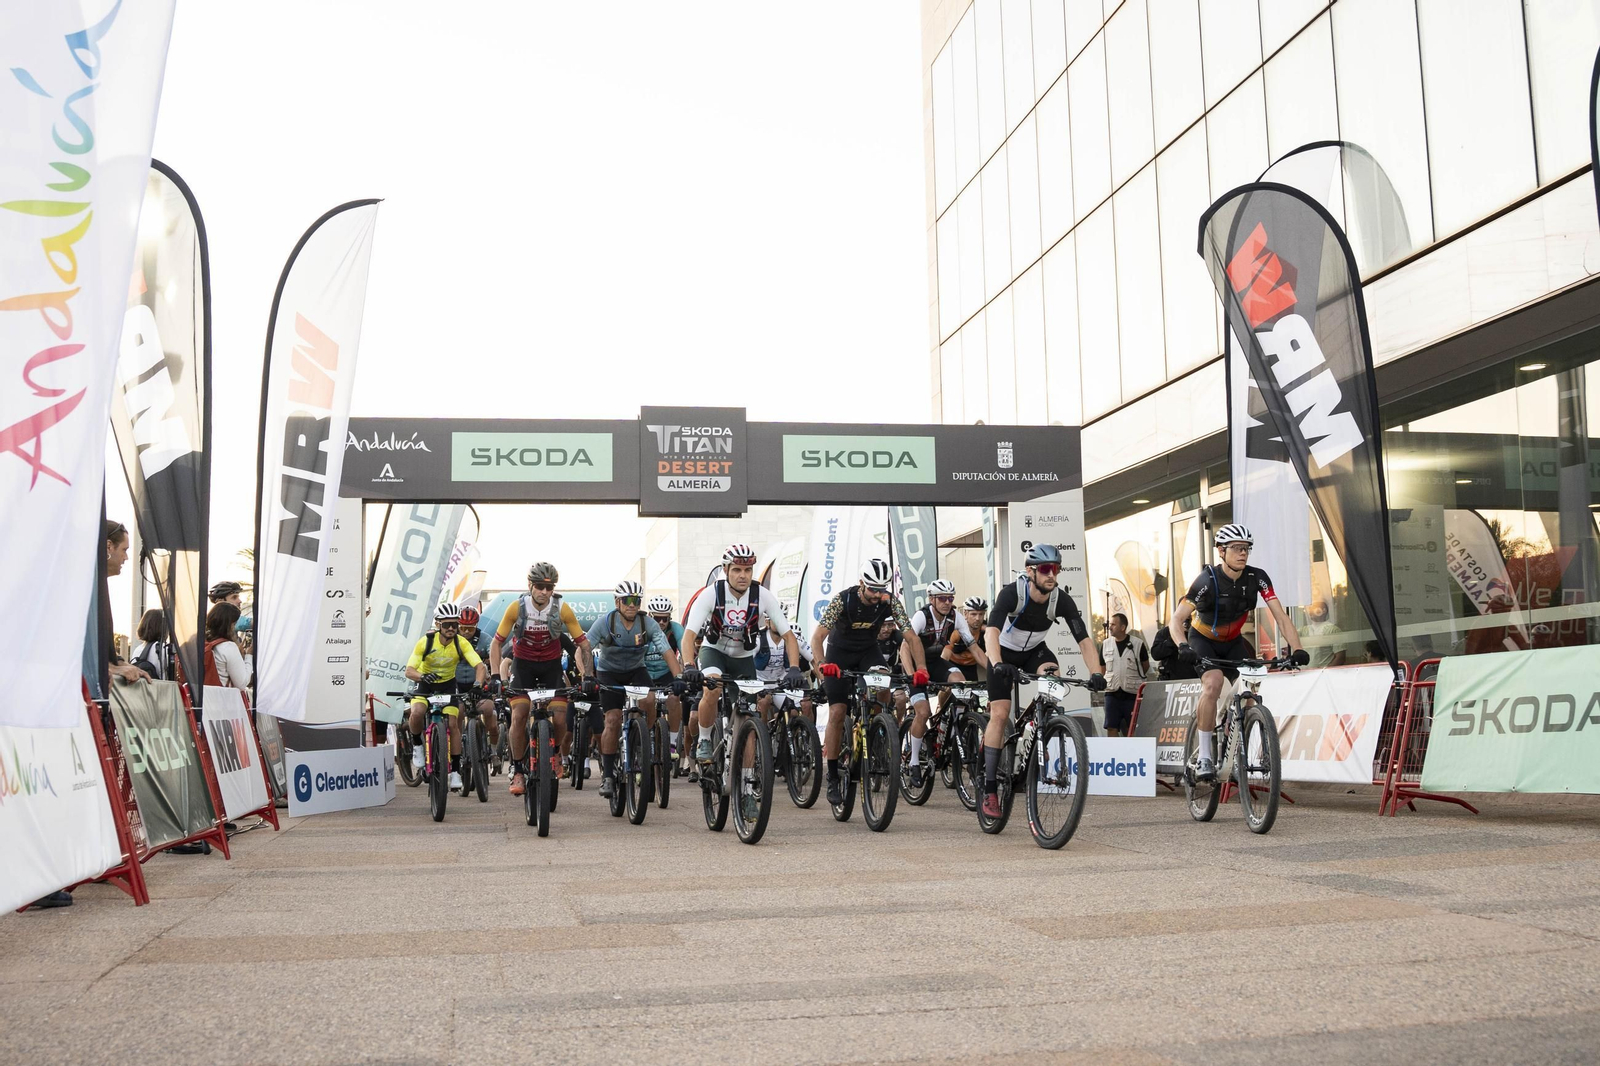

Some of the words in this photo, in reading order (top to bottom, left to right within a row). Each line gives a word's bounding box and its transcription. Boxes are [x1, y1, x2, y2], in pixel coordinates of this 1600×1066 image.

[0, 0, 123, 491] Andalucía
[277, 311, 340, 563] MRW
[344, 431, 432, 452] Andalucía
[646, 424, 733, 455] TITAN
[658, 461, 733, 474] DESERT
[952, 471, 1006, 482] DIPUTACIÓN
[1008, 471, 1020, 481] DE
[1021, 470, 1059, 481] ALMERÍA
[667, 477, 721, 489] ALMERÍA
[1038, 514, 1069, 523] ALMERÍA
[821, 517, 838, 596] Cleardent
[1047, 681, 1057, 691] 94
[1164, 683, 1197, 718] TITA
[208, 718, 251, 774] MRW
[1159, 728, 1188, 742] DESE
[0, 732, 58, 806] dalucía
[315, 767, 379, 793] Cleardent
